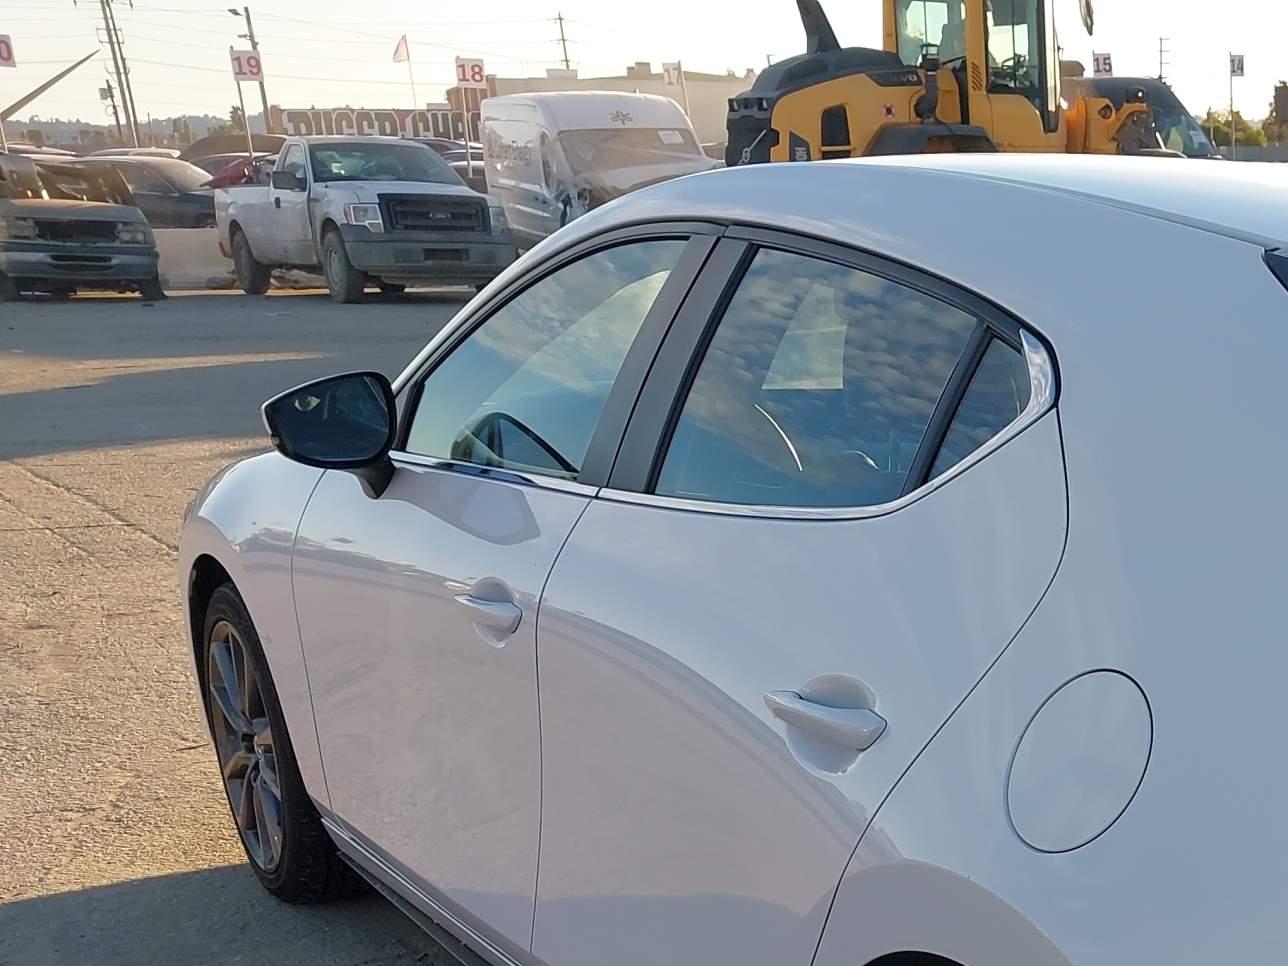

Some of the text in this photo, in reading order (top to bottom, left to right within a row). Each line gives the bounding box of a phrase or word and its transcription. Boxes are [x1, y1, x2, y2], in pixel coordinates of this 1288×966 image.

[232, 56, 261, 76] 19
[457, 64, 484, 82] 18
[1094, 56, 1112, 73] 15
[1230, 58, 1244, 73] 14
